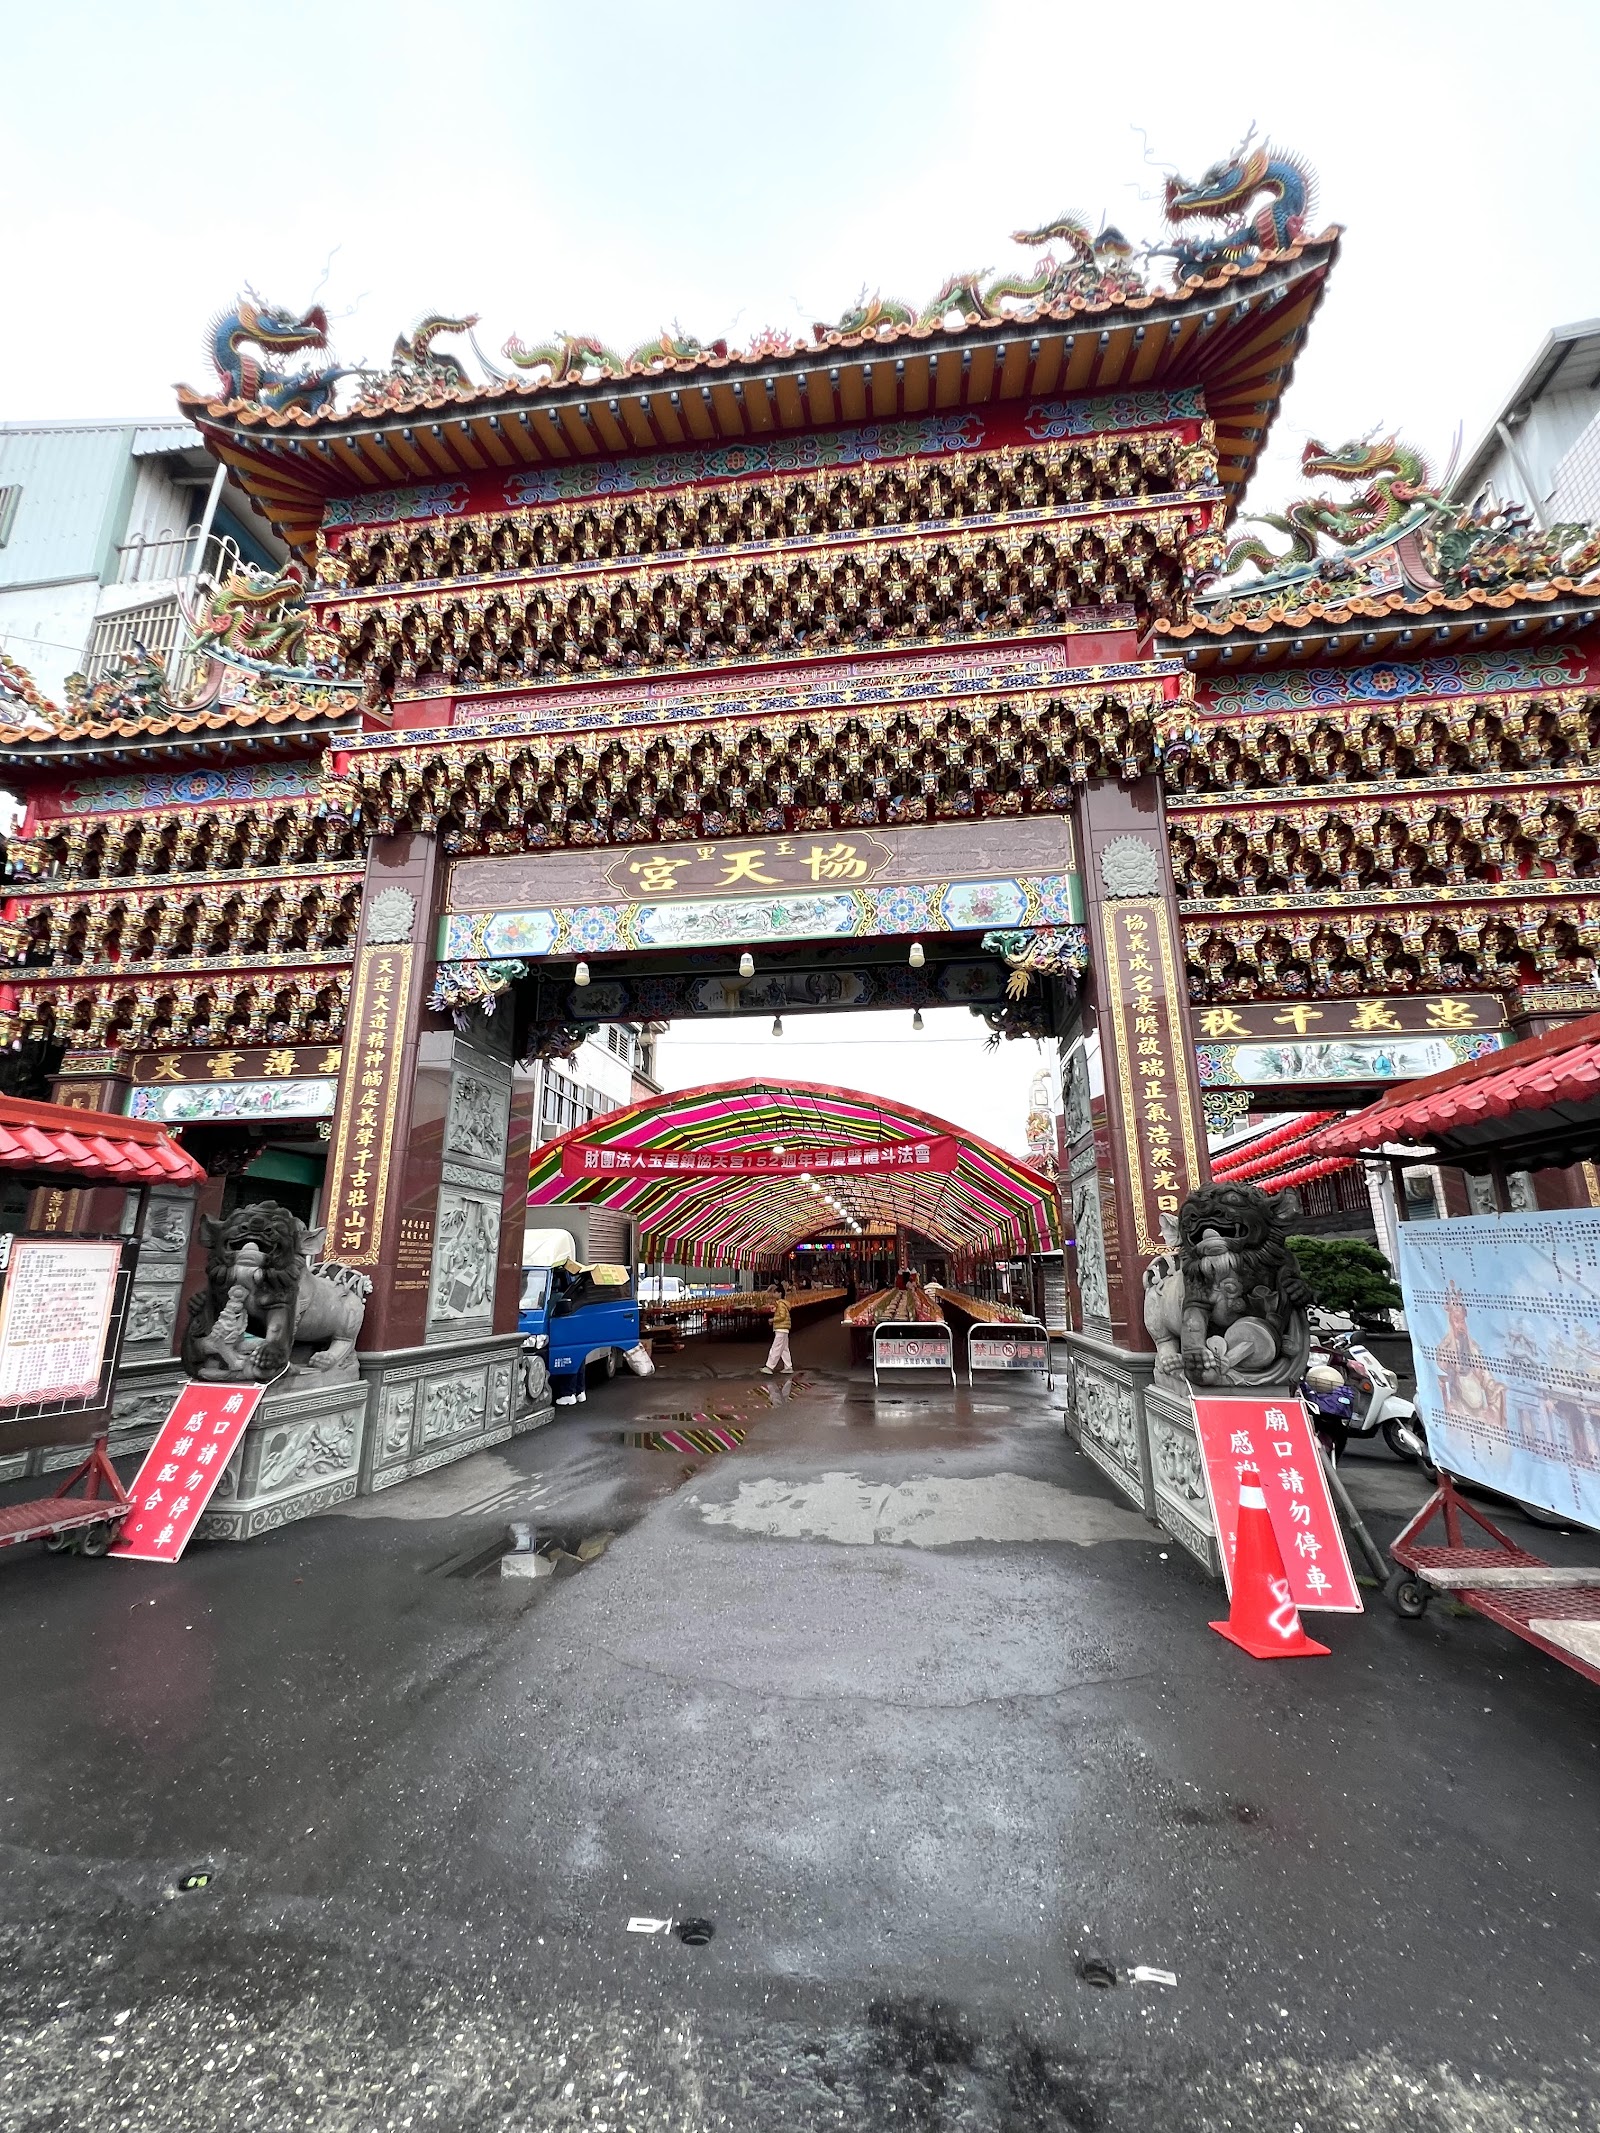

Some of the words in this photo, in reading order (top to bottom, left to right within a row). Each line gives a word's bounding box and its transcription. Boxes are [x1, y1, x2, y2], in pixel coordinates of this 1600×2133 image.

[1122, 914, 1181, 1237] 協義成名豪膽啟瑞正氣浩然光日
[879, 1342, 905, 1356] 禁止
[921, 1342, 948, 1357] 停車
[974, 1343, 1001, 1356] 禁止
[1017, 1344, 1045, 1358] 停車
[153, 1393, 244, 1549] 廟口請勿停車
[1264, 1407, 1332, 1597] 廟口請勿停車
